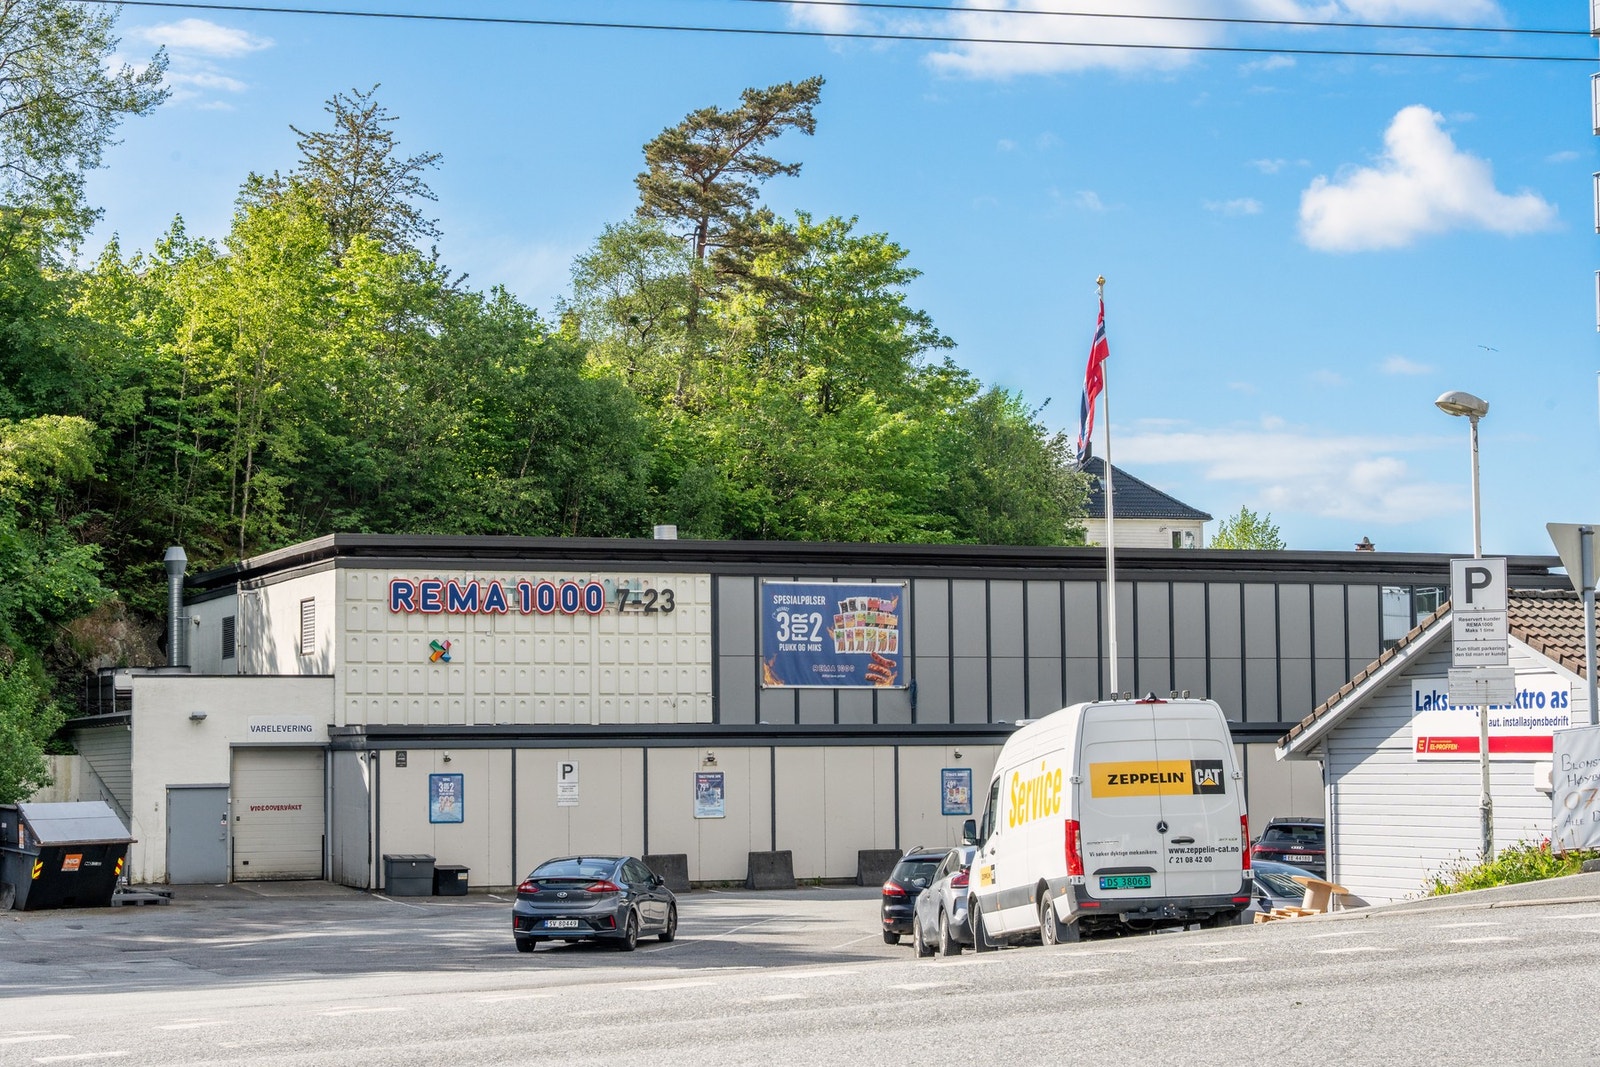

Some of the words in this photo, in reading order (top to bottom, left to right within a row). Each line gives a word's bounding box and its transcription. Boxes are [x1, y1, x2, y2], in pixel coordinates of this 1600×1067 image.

[1465, 567, 1492, 604] P
[390, 579, 509, 615] REMA
[517, 581, 605, 615] 1000
[617, 588, 676, 613] 7-23
[773, 595, 826, 606] SPESIALPØLSER
[776, 611, 790, 642] 3
[791, 613, 809, 641] FOR
[809, 612, 823, 642] 2
[779, 643, 797, 652] PLUKK
[797, 644, 806, 652] OG
[807, 644, 822, 652] MIKS
[1550, 690, 1568, 709] as
[250, 724, 312, 733] VARELEVERING
[1488, 719, 1502, 727] aut.
[1503, 717, 1569, 729] installasjonsbedrift
[562, 764, 573, 780] P
[1194, 768, 1222, 786] CAT
[1107, 772, 1185, 786] ZEPPELIN
[1009, 760, 1062, 828] Service
[250, 803, 302, 811] VIDEOOVERVÅKET
[1110, 850, 1128, 858] dyktige
[1168, 846, 1239, 855] www.zeppelin-cat.no
[1107, 878, 1119, 887] DS
[1122, 876, 1149, 886] 38063
